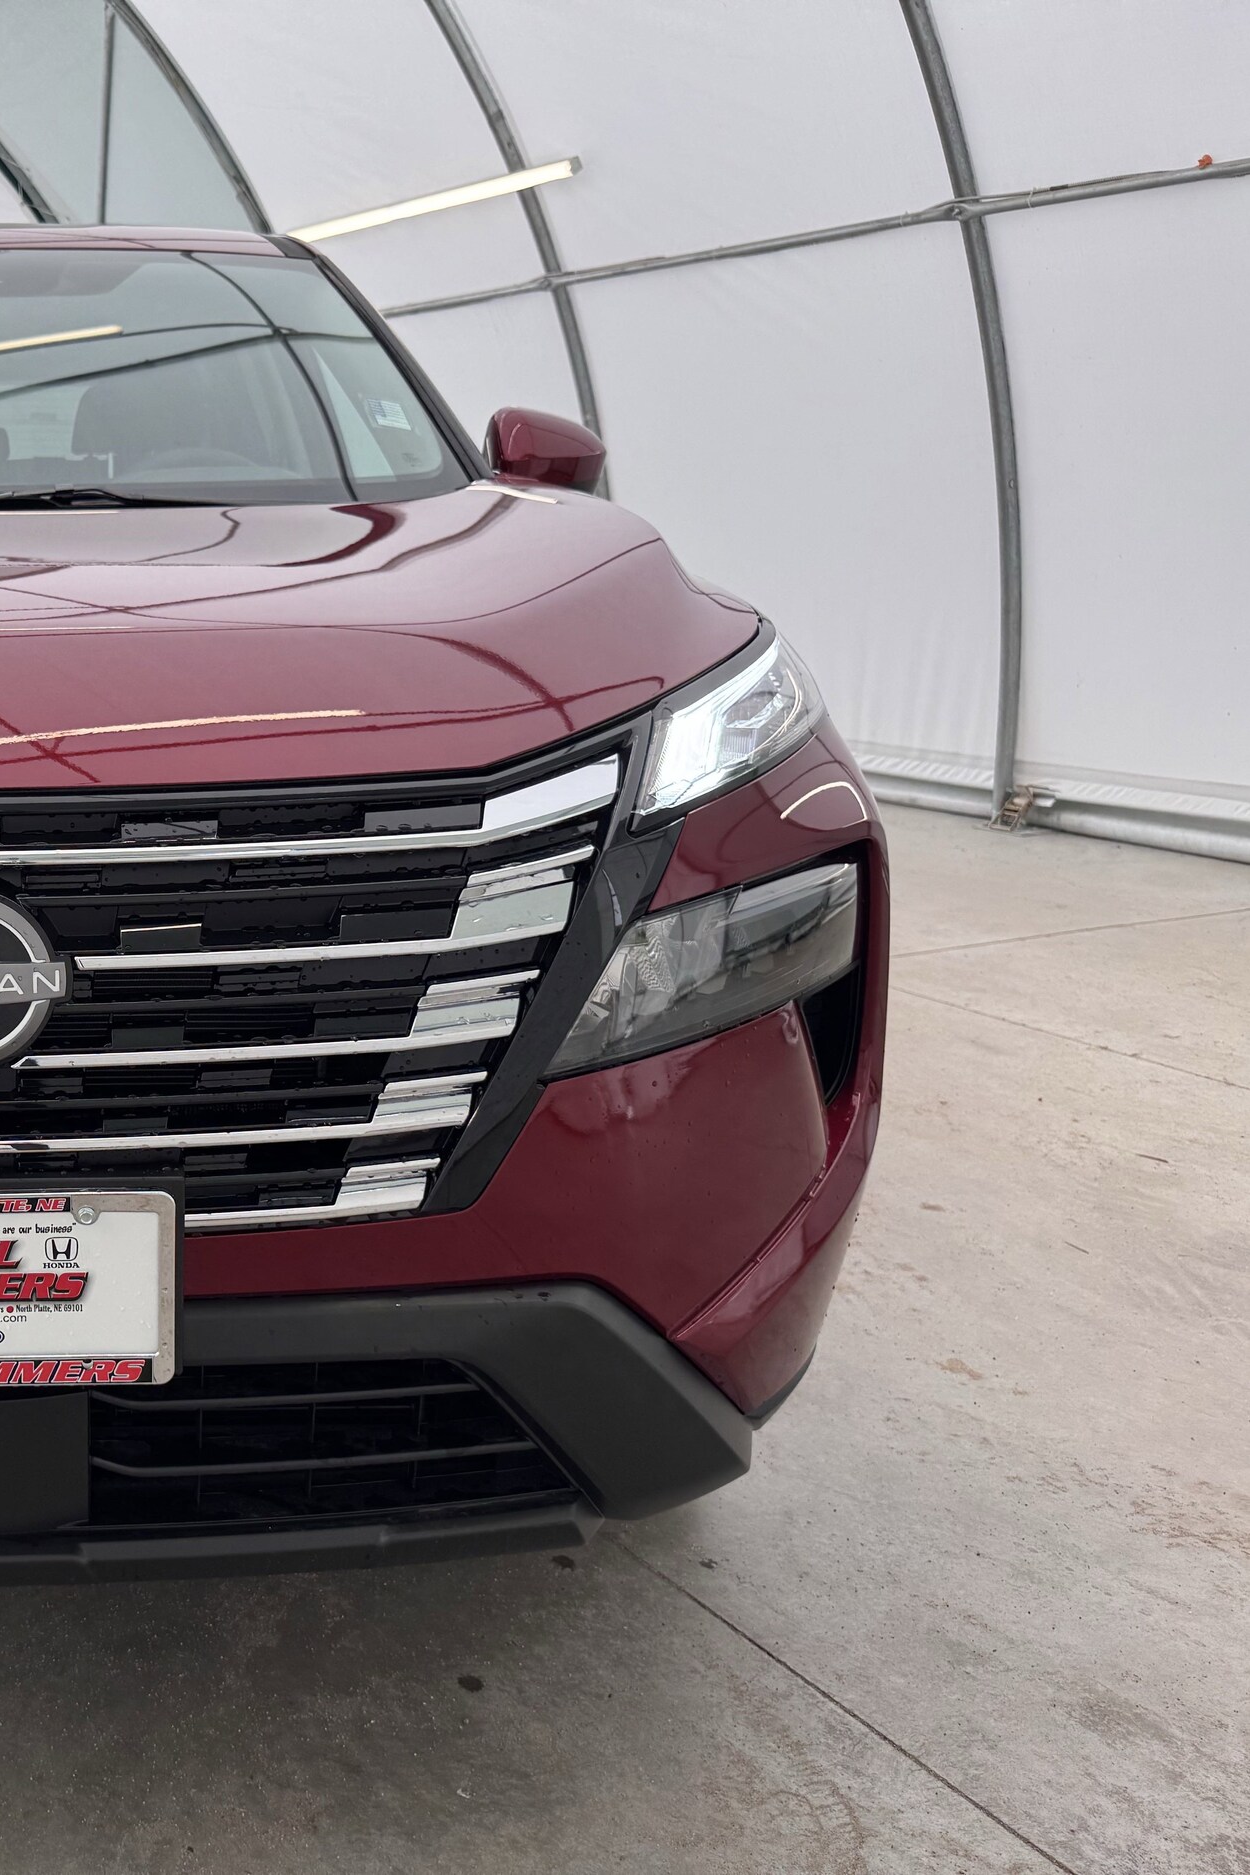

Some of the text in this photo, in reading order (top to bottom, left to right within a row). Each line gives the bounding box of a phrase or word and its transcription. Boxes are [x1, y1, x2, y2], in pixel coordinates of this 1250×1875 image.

[34, 1197, 67, 1212] NE
[2, 1226, 16, 1235] are
[18, 1225, 32, 1234] our
[15, 1303, 33, 1313] North
[33, 1303, 53, 1313] Platte,
[53, 1303, 63, 1312] NE
[63, 1303, 83, 1312] 69101
